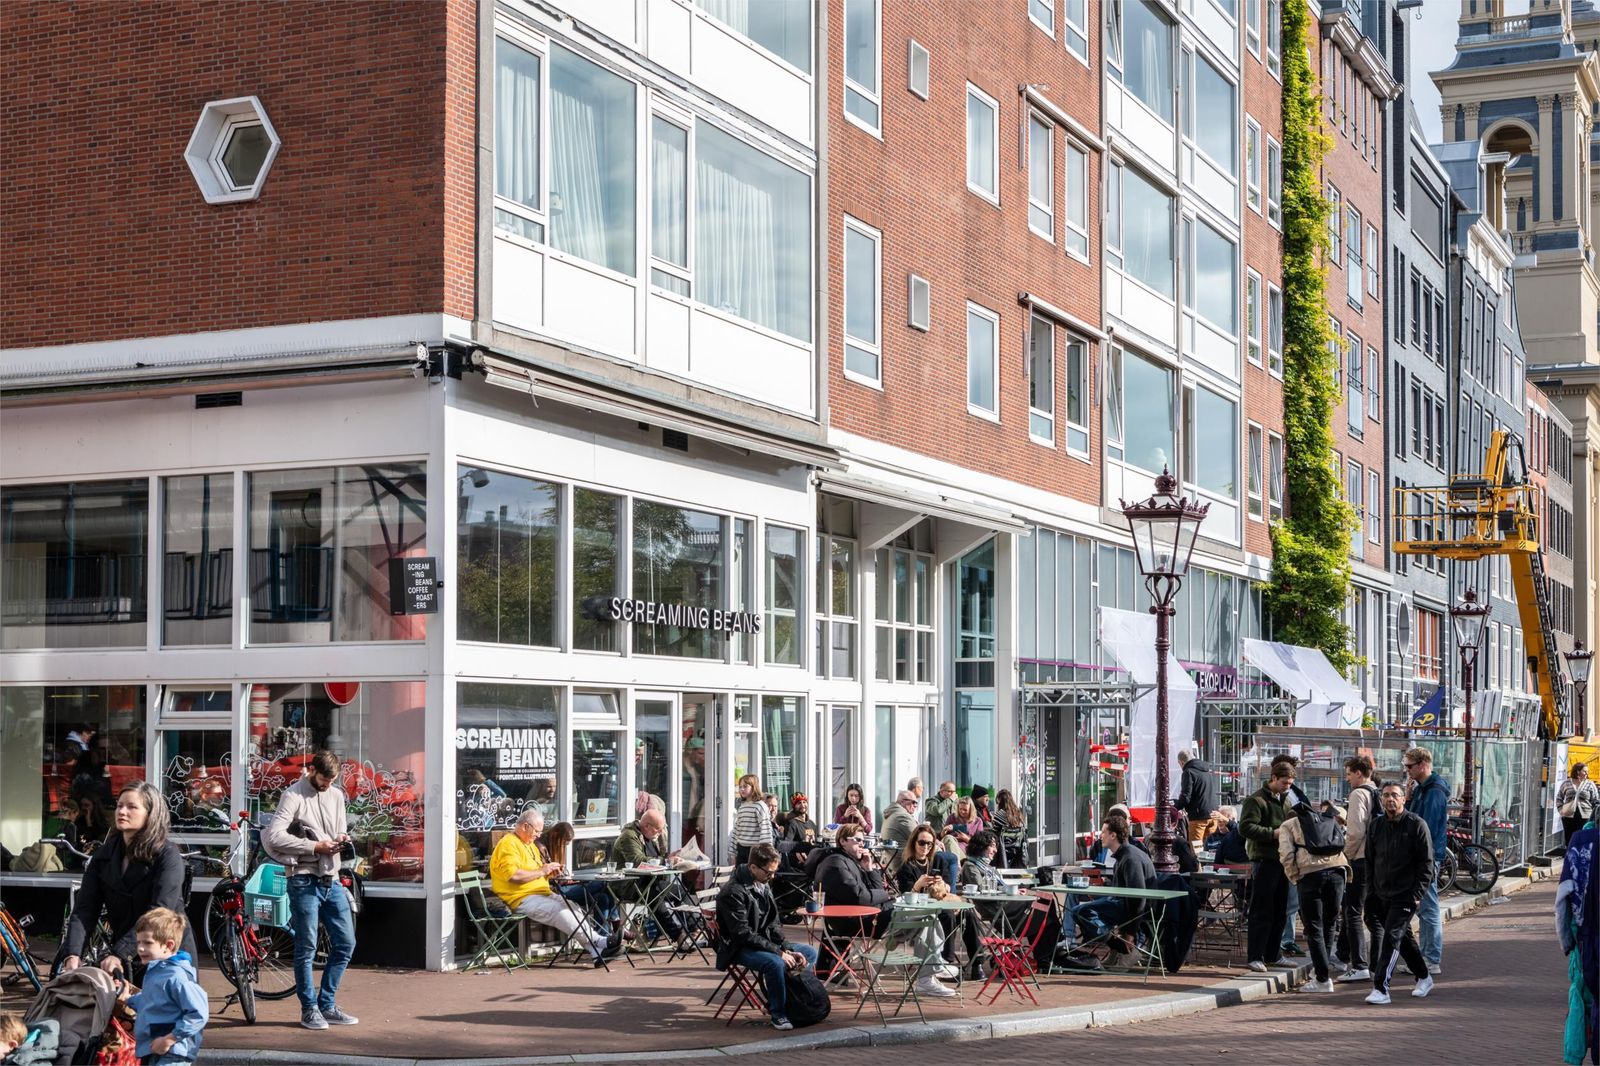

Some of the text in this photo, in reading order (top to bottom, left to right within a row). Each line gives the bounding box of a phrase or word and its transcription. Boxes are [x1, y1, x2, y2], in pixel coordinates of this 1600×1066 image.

[407, 563, 430, 571] SCREAM
[415, 578, 433, 586] BEANS
[407, 586, 429, 594] COFFEE
[415, 593, 433, 601] ROAST
[412, 601, 427, 609] -ERS
[611, 597, 762, 635] SCREAMING BEANS
[1200, 671, 1237, 694] EKOPLAZA
[456, 728, 557, 749] SCREAMING
[499, 748, 557, 768] BEANS
